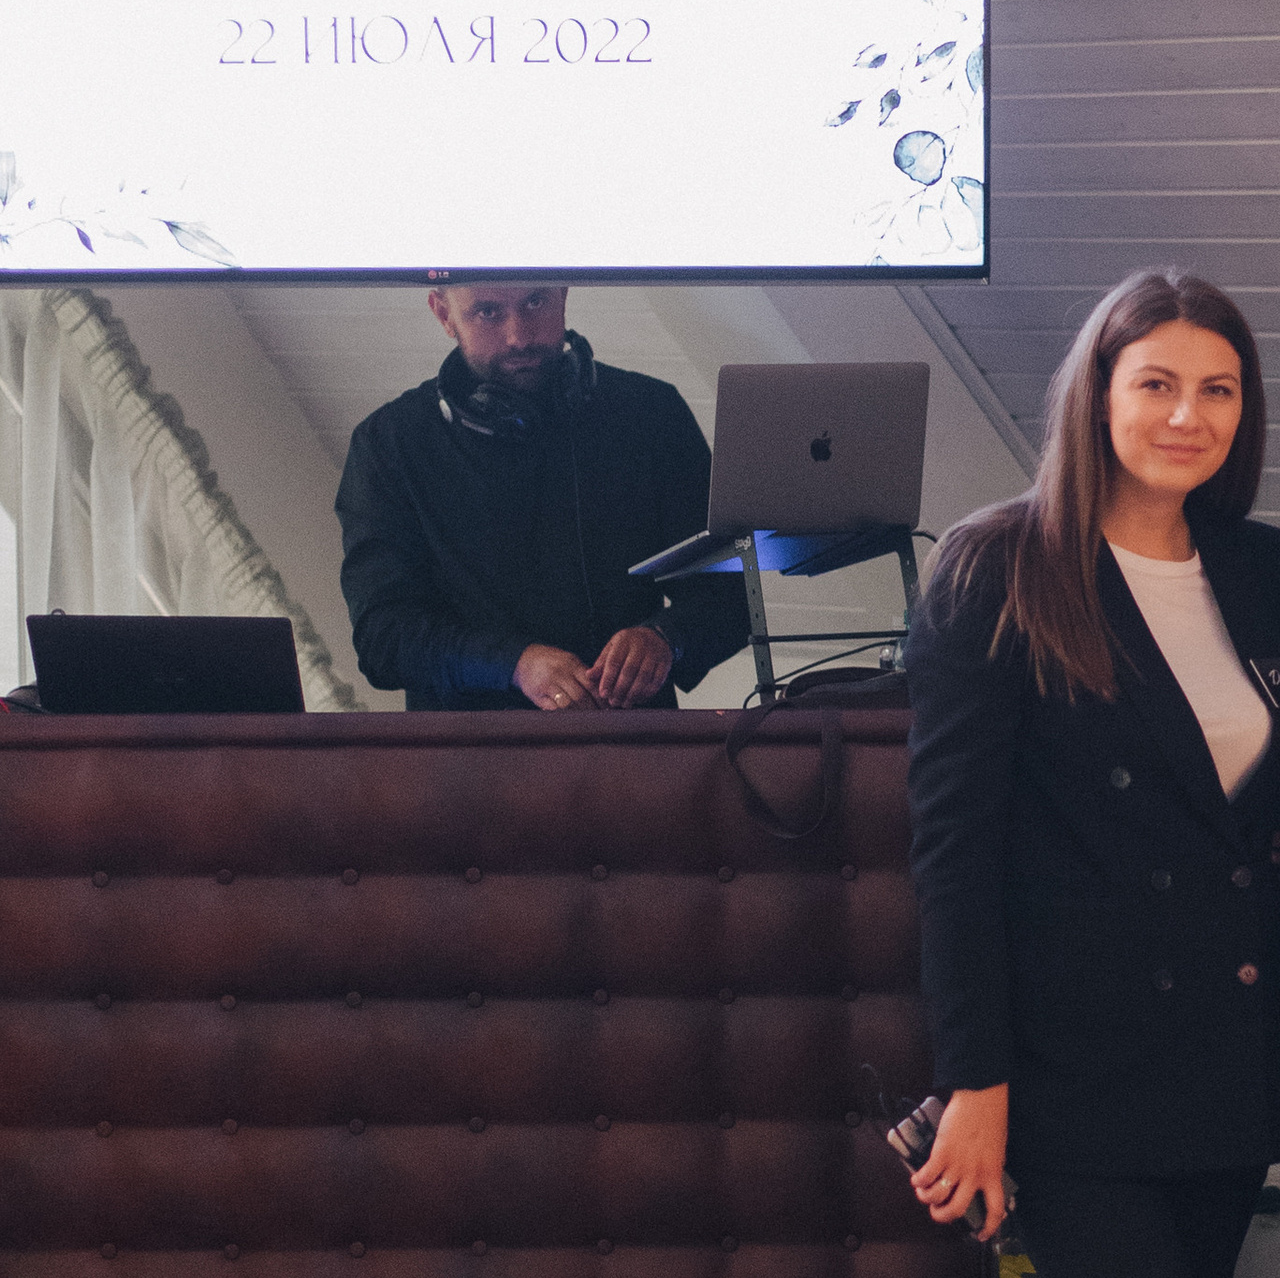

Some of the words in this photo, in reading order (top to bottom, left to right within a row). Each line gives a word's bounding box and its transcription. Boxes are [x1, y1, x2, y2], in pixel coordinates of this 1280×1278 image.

[218, 17, 279, 64] 22
[302, 15, 498, 65] ИЮЛЯ
[522, 16, 654, 64] 2022
